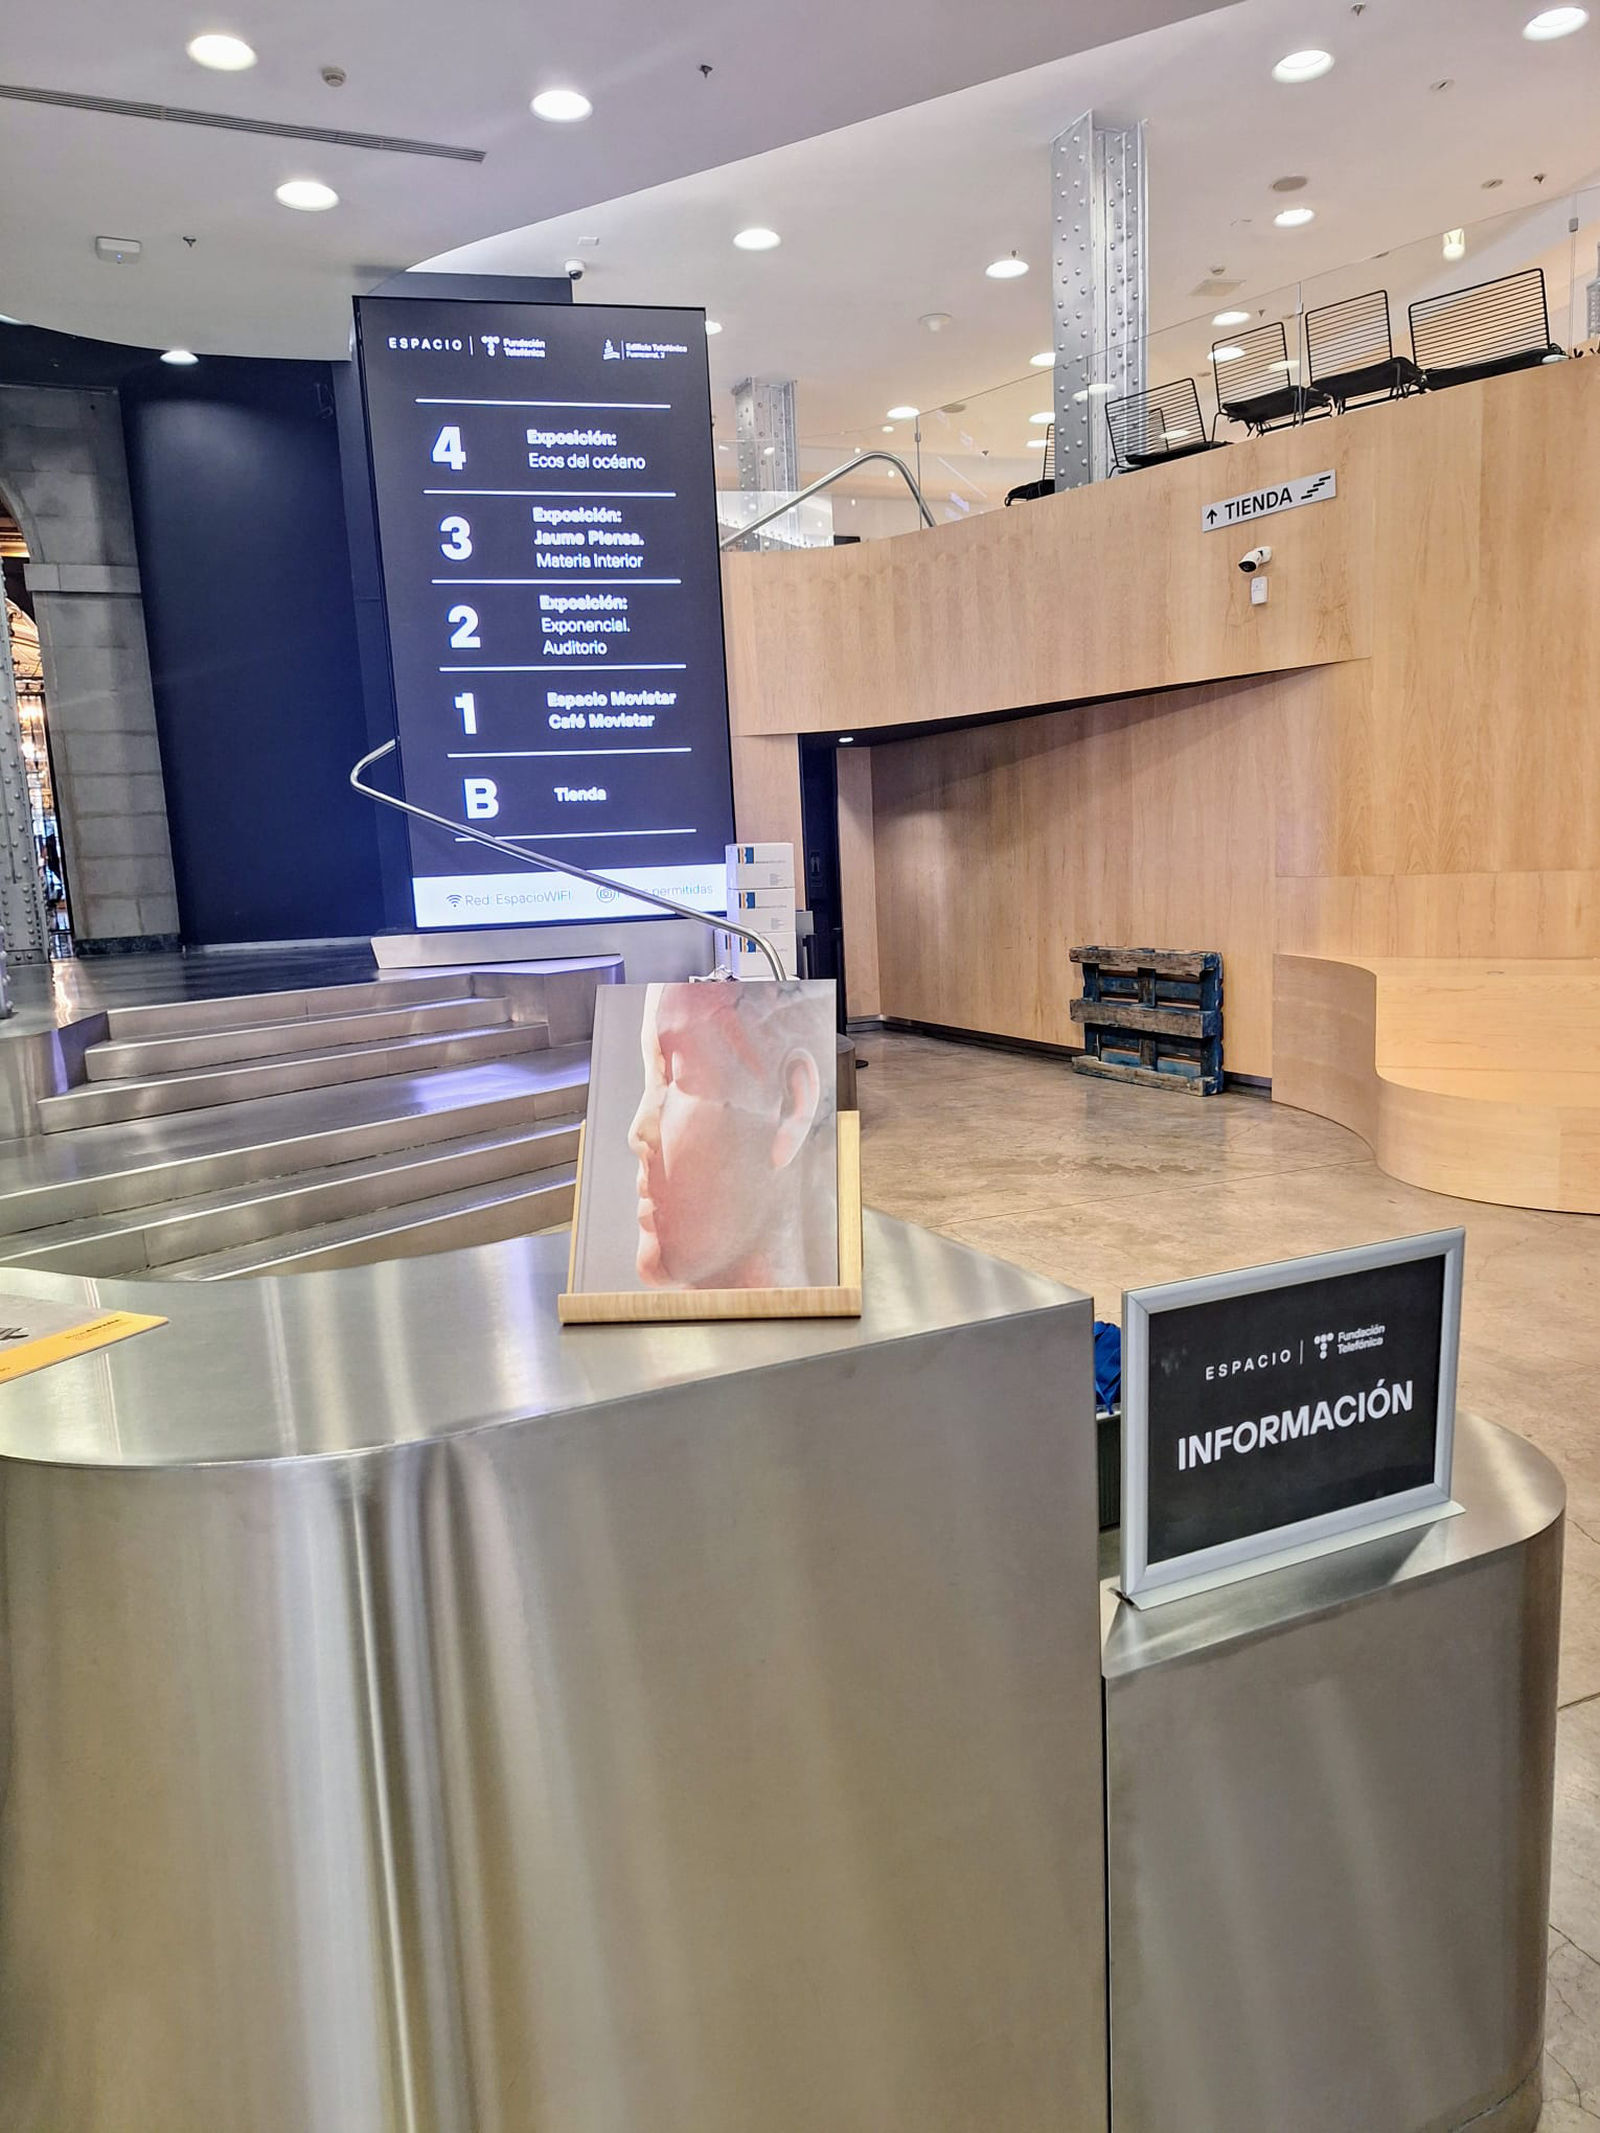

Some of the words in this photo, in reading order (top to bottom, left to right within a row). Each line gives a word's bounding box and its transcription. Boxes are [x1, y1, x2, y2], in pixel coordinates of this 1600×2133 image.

[388, 337, 462, 351] ESPACIO
[503, 338, 546, 349] Fundación
[504, 348, 546, 358] Telefónica
[527, 429, 617, 447] Exposición:
[432, 426, 466, 471] 4
[529, 453, 564, 469] Ecos
[567, 452, 590, 469] del
[592, 453, 646, 470] océano
[1224, 488, 1292, 520] TIENDA
[533, 506, 622, 525] Exposición:
[439, 516, 473, 561] 3
[534, 530, 585, 546] Jaume
[588, 530, 644, 546] Plensa.
[536, 553, 591, 569] Materia
[594, 552, 644, 568] Interior
[540, 594, 627, 612] Exposición:
[447, 604, 481, 648] 2
[542, 618, 630, 634] Exponencial.
[543, 640, 608, 656] Auditorio
[547, 692, 608, 709] Espacio
[610, 691, 676, 706] Movistar
[454, 692, 478, 735] 1
[548, 713, 586, 729] Café
[589, 713, 654, 728] Movistar
[463, 778, 500, 820] B
[554, 787, 607, 802] Tienda
[1338, 1324, 1386, 1342] Fundación
[1338, 1336, 1384, 1354] Telefónica
[1206, 1349, 1292, 1380] ESPACIO
[1178, 1379, 1414, 1470] INFORMACIÓN
